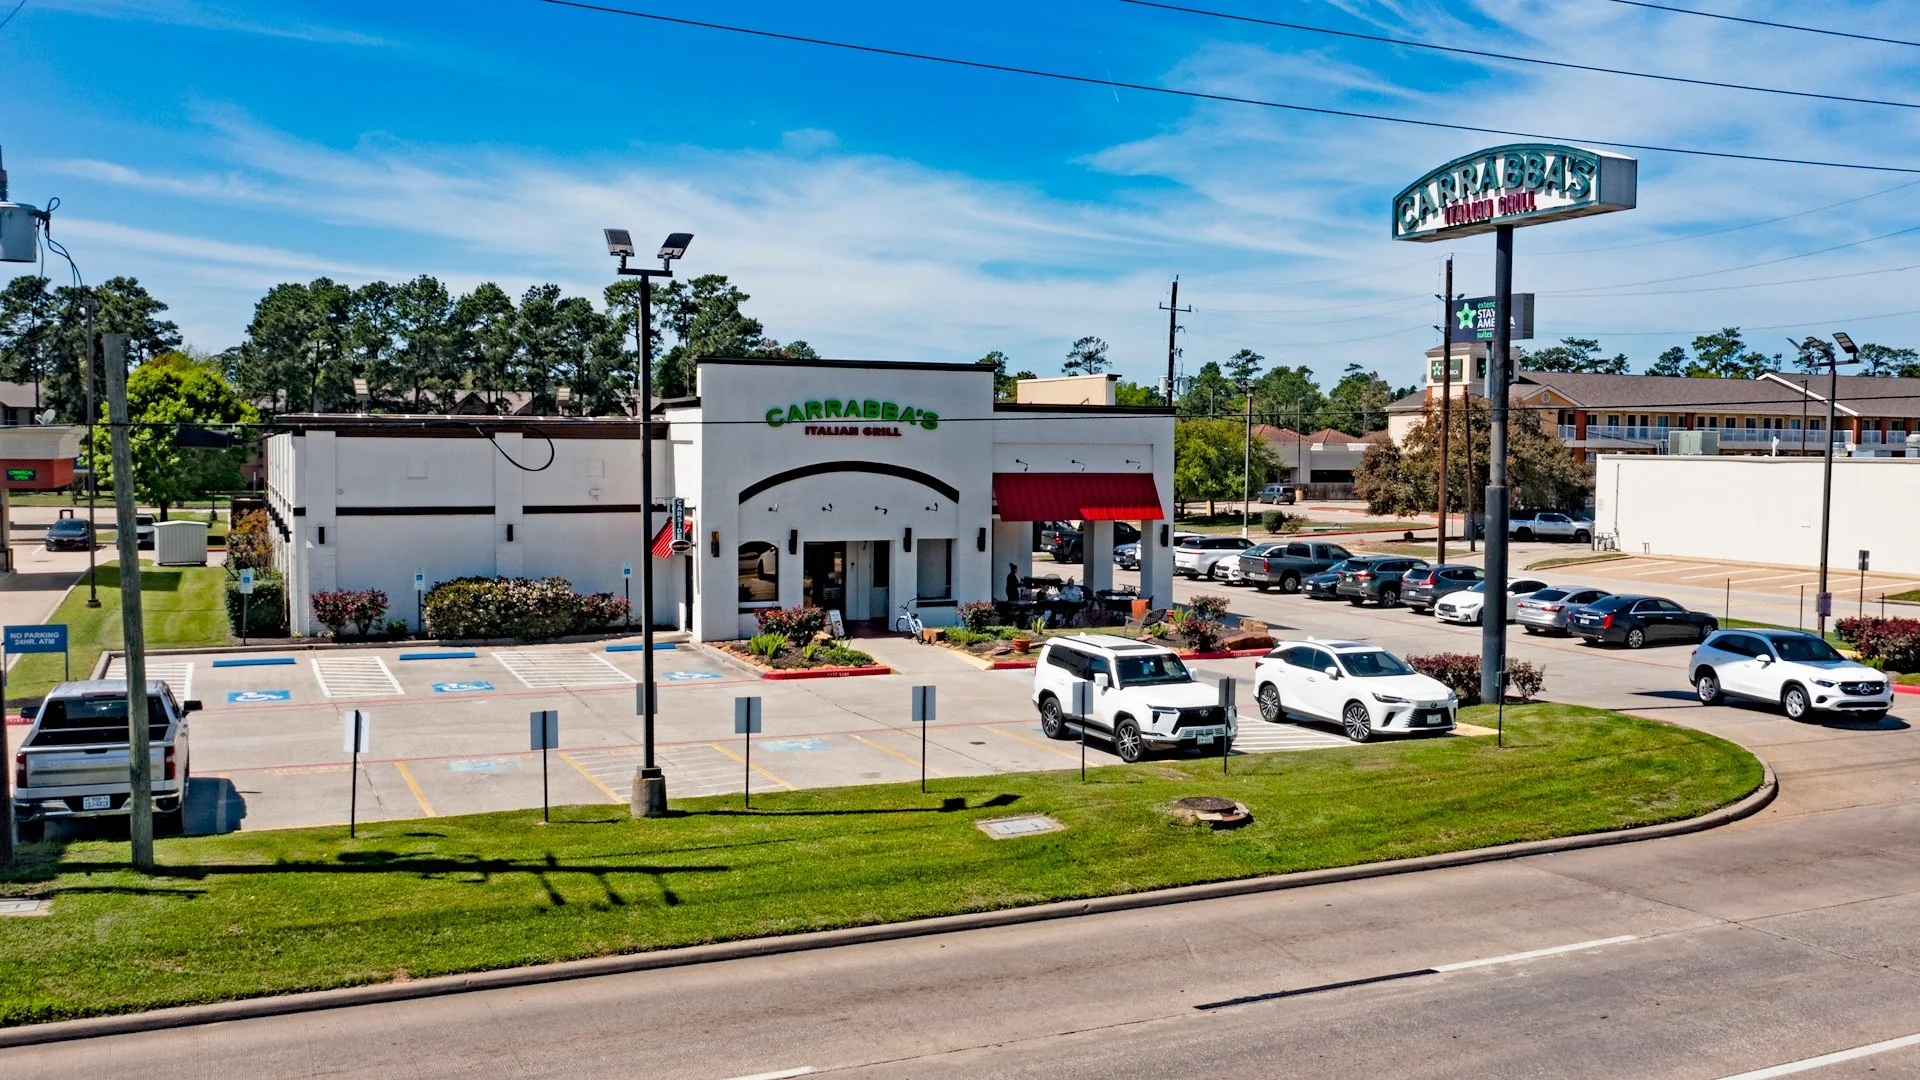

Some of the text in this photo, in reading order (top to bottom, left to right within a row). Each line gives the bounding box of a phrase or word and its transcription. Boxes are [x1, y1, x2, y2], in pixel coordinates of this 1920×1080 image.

[1398, 152, 1596, 229] CARRABBA'S
[1444, 191, 1536, 225] ITALIAN GRILL
[1477, 316, 1516, 328] AMEA
[1477, 331, 1493, 339] suites
[765, 400, 940, 430] CARRABBA'S
[805, 426, 902, 437] ITALIAN GRILL
[24, 631, 59, 639] PARKING
